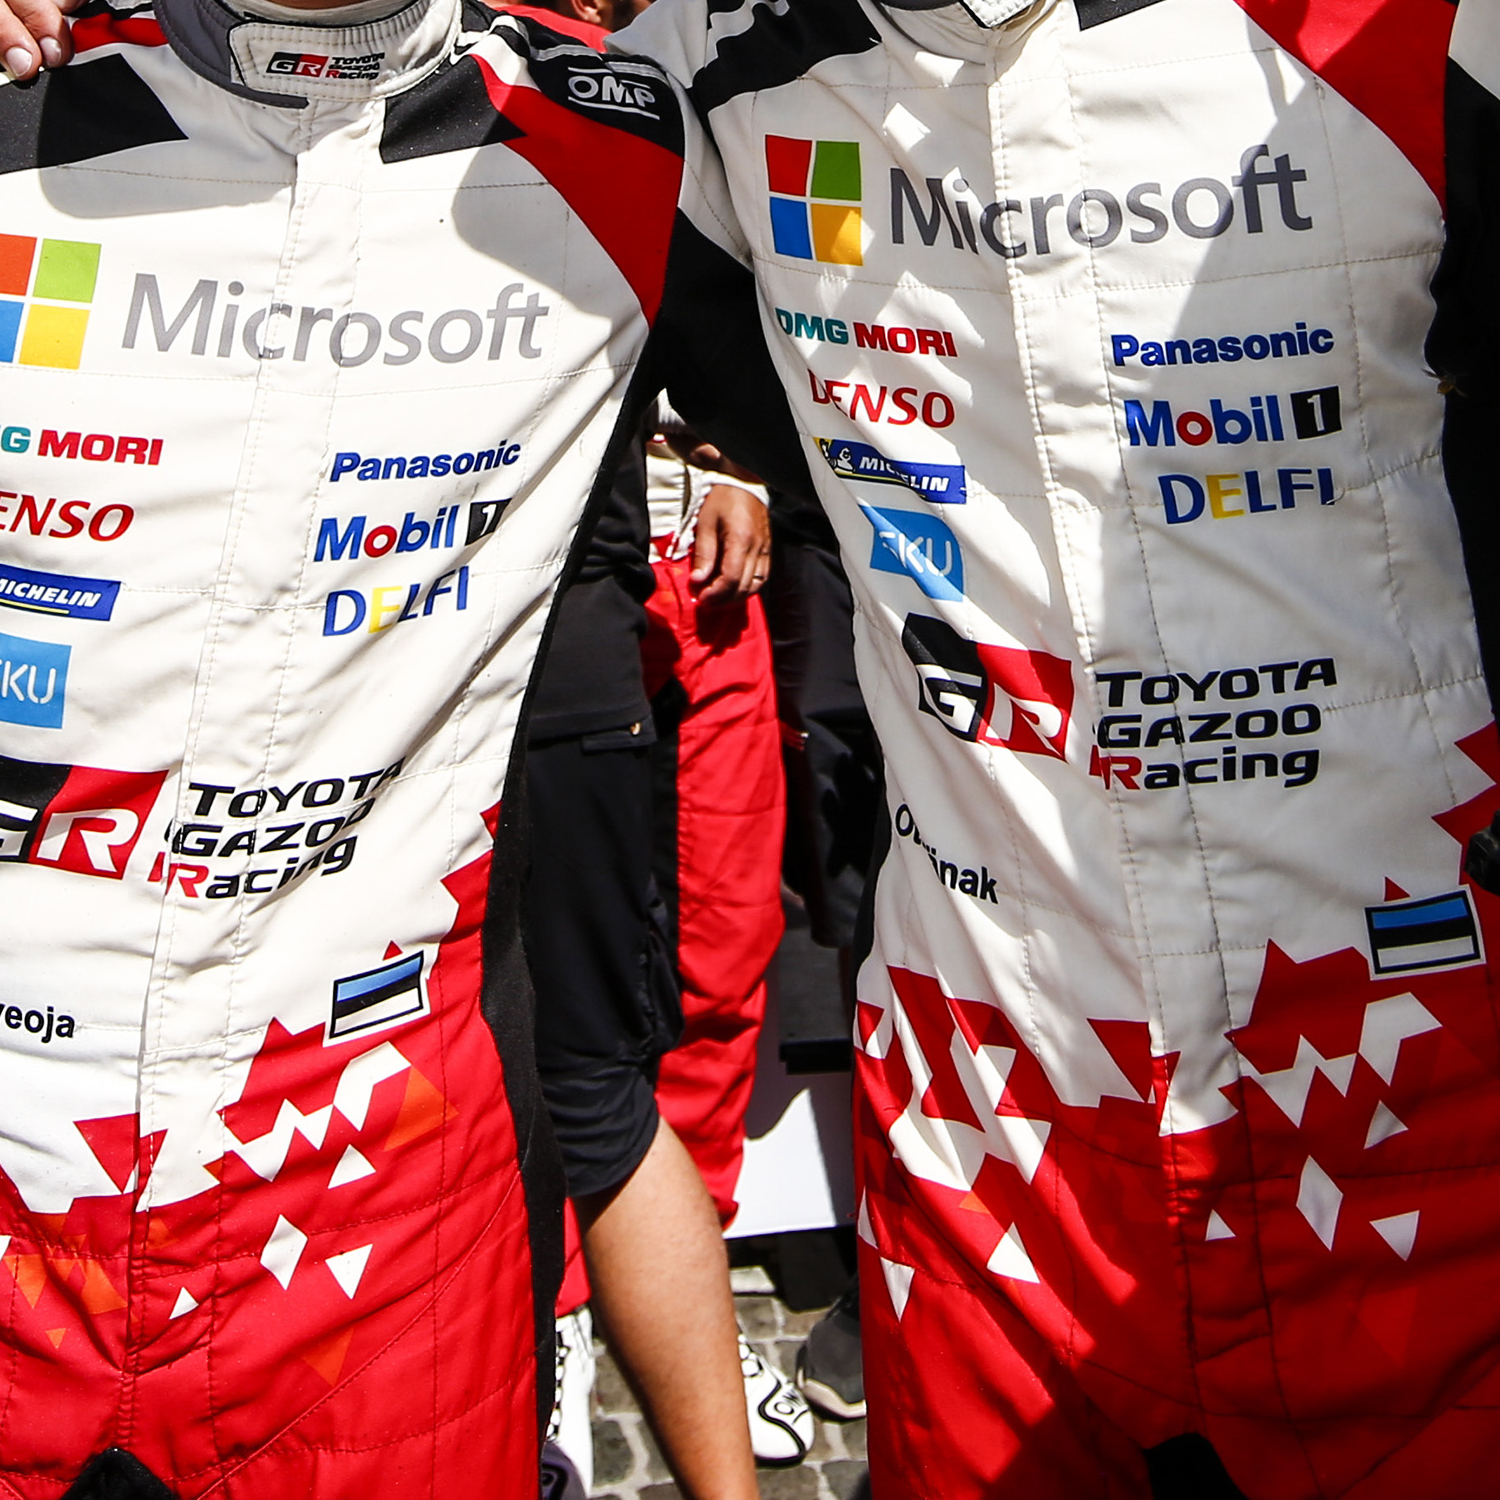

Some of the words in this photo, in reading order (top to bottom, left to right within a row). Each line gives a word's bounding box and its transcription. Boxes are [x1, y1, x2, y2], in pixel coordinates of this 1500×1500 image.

[270, 59, 320, 76] GR
[568, 76, 656, 111] OMP
[890, 144, 1313, 259] Microsoft
[123, 273, 550, 368] Microsoft
[775, 307, 849, 345] DMG
[853, 322, 958, 358] MORI
[1111, 321, 1335, 368] Panasonic
[1123, 394, 1285, 447] Mobil
[1303, 393, 1324, 433] 1
[38, 430, 163, 466] MORI
[330, 438, 521, 482] Panasonic
[1158, 466, 1335, 525] DELFI
[314, 504, 455, 562] Mobil
[478, 503, 499, 537] 1
[323, 566, 469, 637] DELFI
[915, 663, 1063, 756] GR
[1095, 657, 1338, 708] TOYOTA
[1092, 703, 1323, 749] GAZOO
[187, 758, 407, 818] TOYOTA
[1089, 745, 1321, 790] Racing
[166, 797, 374, 858] GAZOO
[147, 835, 358, 900] Racing
